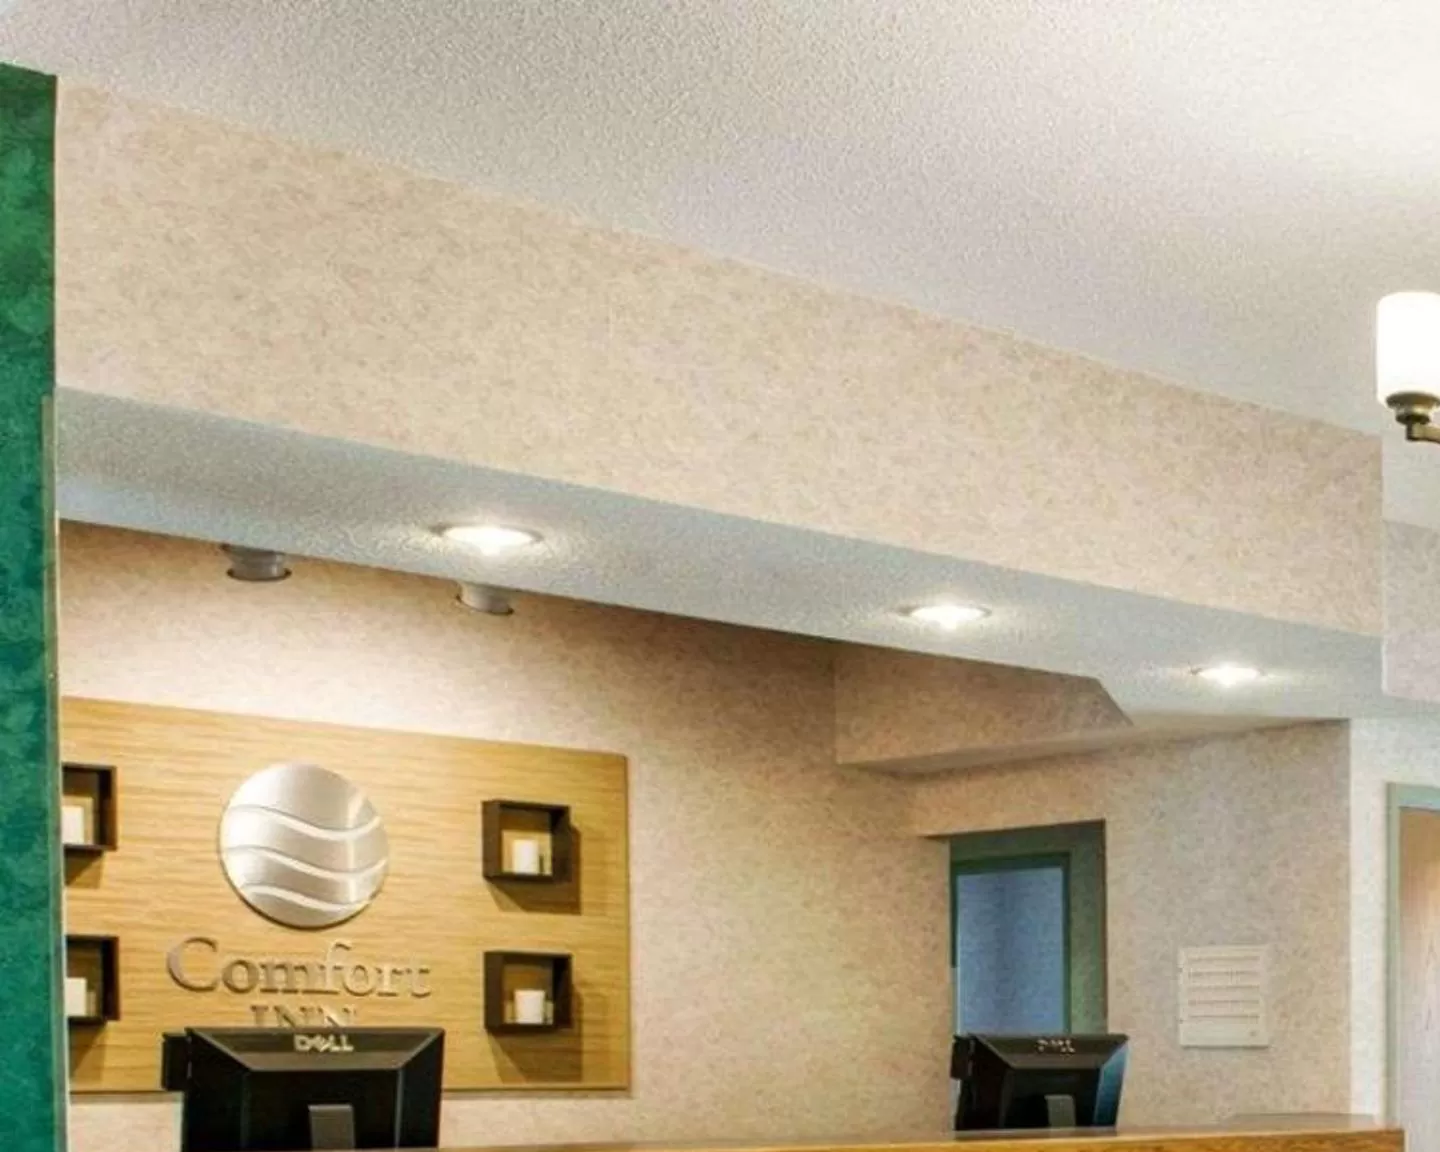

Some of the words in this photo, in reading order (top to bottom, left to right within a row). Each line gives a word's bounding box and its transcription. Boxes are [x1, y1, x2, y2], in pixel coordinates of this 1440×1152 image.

[167, 936, 432, 998] Comfort
[251, 1004, 357, 1028] INN
[294, 1034, 355, 1052] DELL
